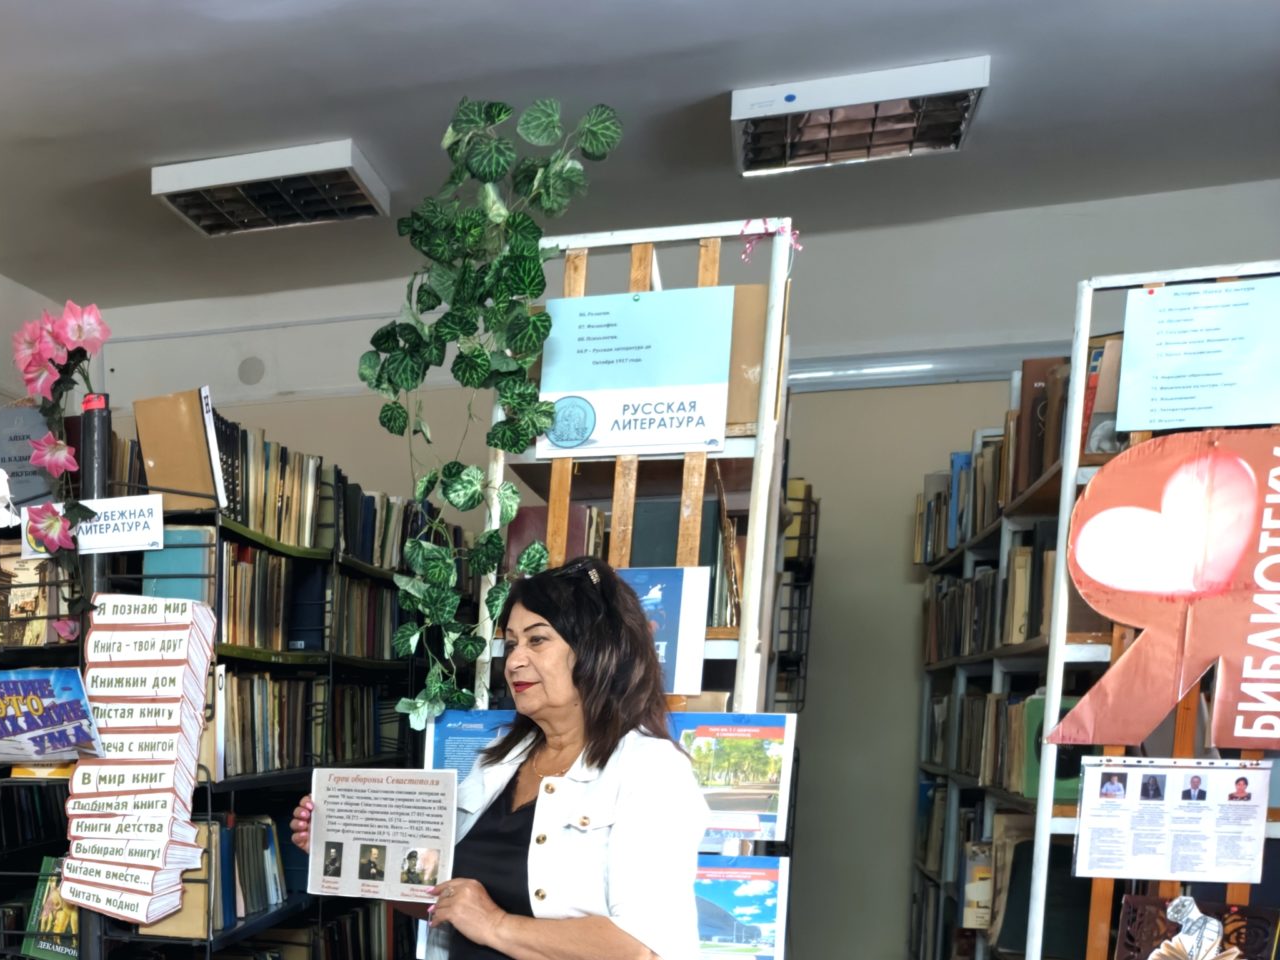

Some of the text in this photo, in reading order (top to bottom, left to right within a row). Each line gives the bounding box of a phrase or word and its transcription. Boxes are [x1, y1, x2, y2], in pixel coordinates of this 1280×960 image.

[622, 401, 696, 415] РУССКАЯ
[611, 415, 705, 431] ЛИТЕРАТУРА
[92, 508, 154, 522] УБЕЖНАЯ
[76, 521, 151, 536] ЛИТЕРАТУРА
[97, 602, 187, 616] Я познаю мир
[93, 640, 122, 653] Книга
[133, 638, 156, 652] твой
[159, 639, 183, 653] друг
[91, 675, 176, 689] Книжкин дом
[139, 708, 174, 720] книгу
[28, 726, 94, 755] УМА
[138, 739, 174, 752] книгой
[81, 772, 166, 786] В мир книг
[72, 800, 167, 811] Любимая книга
[76, 821, 163, 834] Книги детства
[75, 843, 161, 860] Выбираю книгу!
[66, 863, 101, 877] Читаем
[69, 887, 139, 912] Читать модно!
